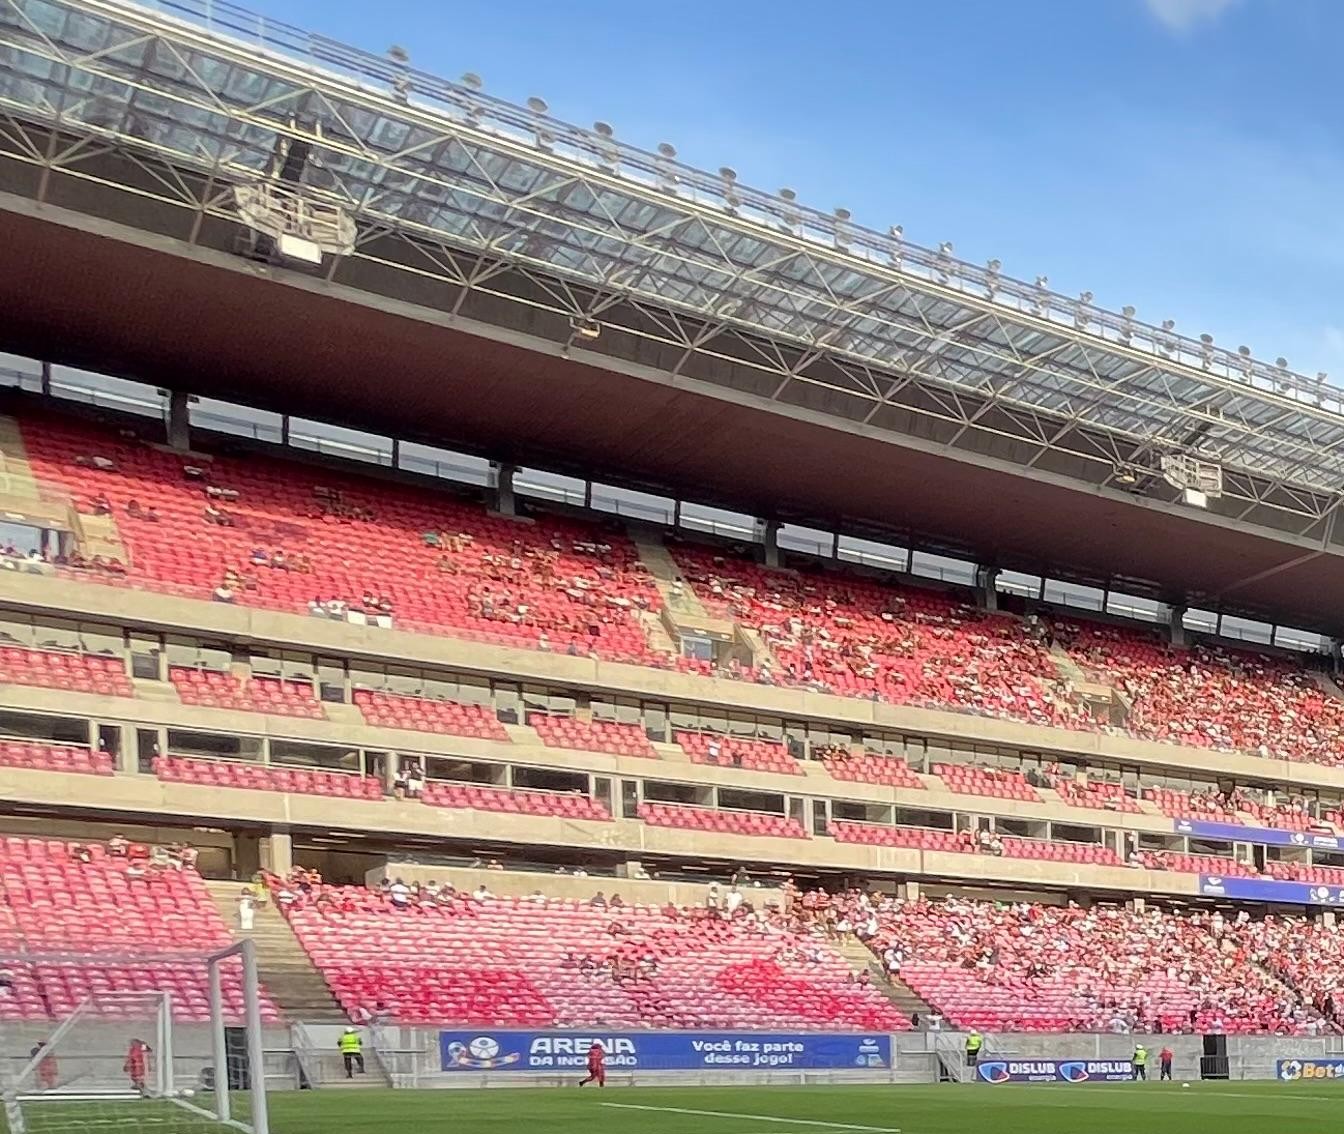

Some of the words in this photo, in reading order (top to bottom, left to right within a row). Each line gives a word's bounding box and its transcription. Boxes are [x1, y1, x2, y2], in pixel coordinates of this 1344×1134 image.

[529, 1038, 637, 1054] ARENA
[692, 1040, 733, 1052] Você
[735, 1040, 760, 1052] faz
[763, 1041, 805, 1054] parte
[529, 1056, 554, 1066] DA
[557, 1054, 638, 1066] INCSÃO
[704, 1053, 751, 1064] desse
[752, 1053, 793, 1066] jogo!
[1009, 1062, 1056, 1074] DISLUB
[1088, 1062, 1133, 1074] DISLUB
[1302, 1063, 1336, 1078] Bet
